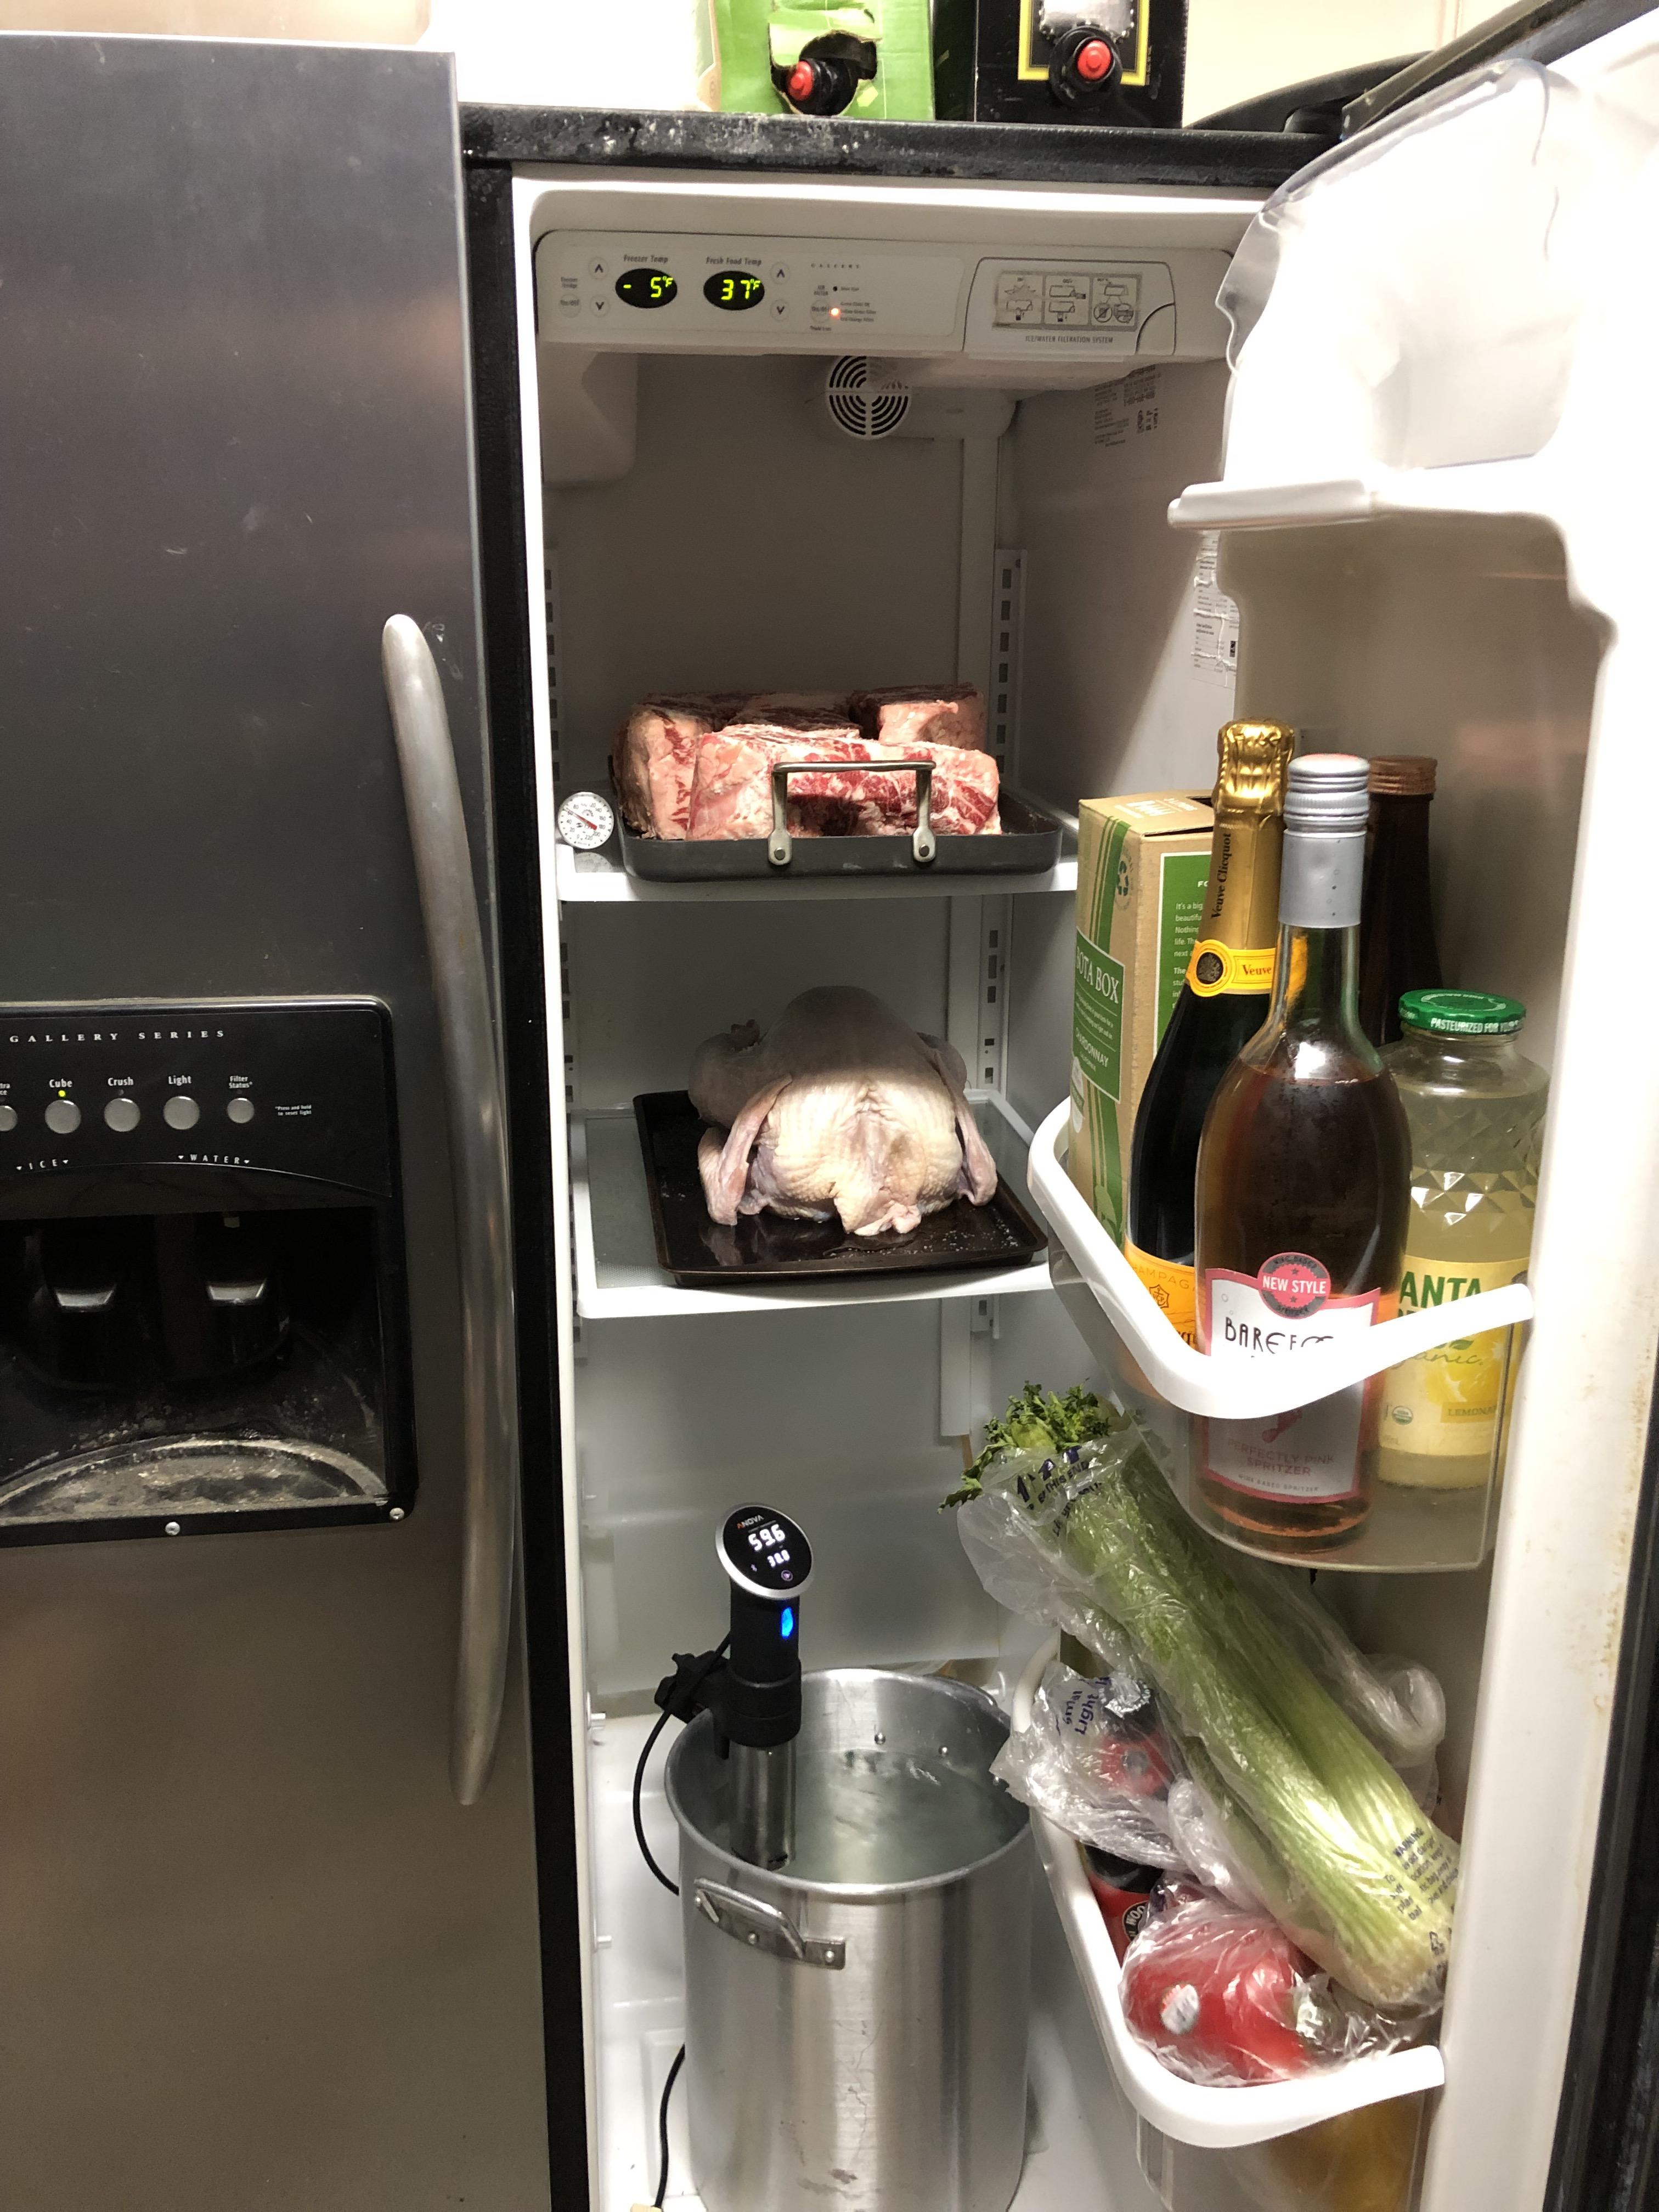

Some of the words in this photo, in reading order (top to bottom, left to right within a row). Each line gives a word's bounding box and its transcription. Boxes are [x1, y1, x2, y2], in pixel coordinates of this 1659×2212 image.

[651, 255, 668, 264] Temp
[744, 258, 761, 267] Temp
[1217, 833, 1233, 883] Clicquot
[1211, 885, 1226, 918] Veuve
[1242, 964, 1272, 975] Veuve
[1095, 967, 1119, 1004] BOX
[1431, 1017, 1483, 1033] PASTEURIZED
[1484, 1023, 1499, 1032] FOR
[9, 1033, 118, 1043] GALLERY
[138, 1030, 224, 1040] SERIES
[49, 1078, 73, 1088] Cube
[108, 1076, 134, 1086] Crush
[168, 1075, 191, 1086] Light
[29, 1159, 58, 1170] ICE
[190, 1154, 240, 1165] WATER
[1132, 1266, 1195, 1291] AMPAG
[1262, 1276, 1289, 1291] NEW
[1291, 1280, 1327, 1294] STYLE
[1400, 1271, 1482, 1308] ANTA
[1228, 1438, 1300, 1464] PERFECTLY
[1304, 1454, 1335, 1465] PINK
[1246, 1457, 1311, 1476] SPRITZER
[736, 1514, 764, 1530] ANOVA
[1392, 1826, 1425, 1858] WARNING
